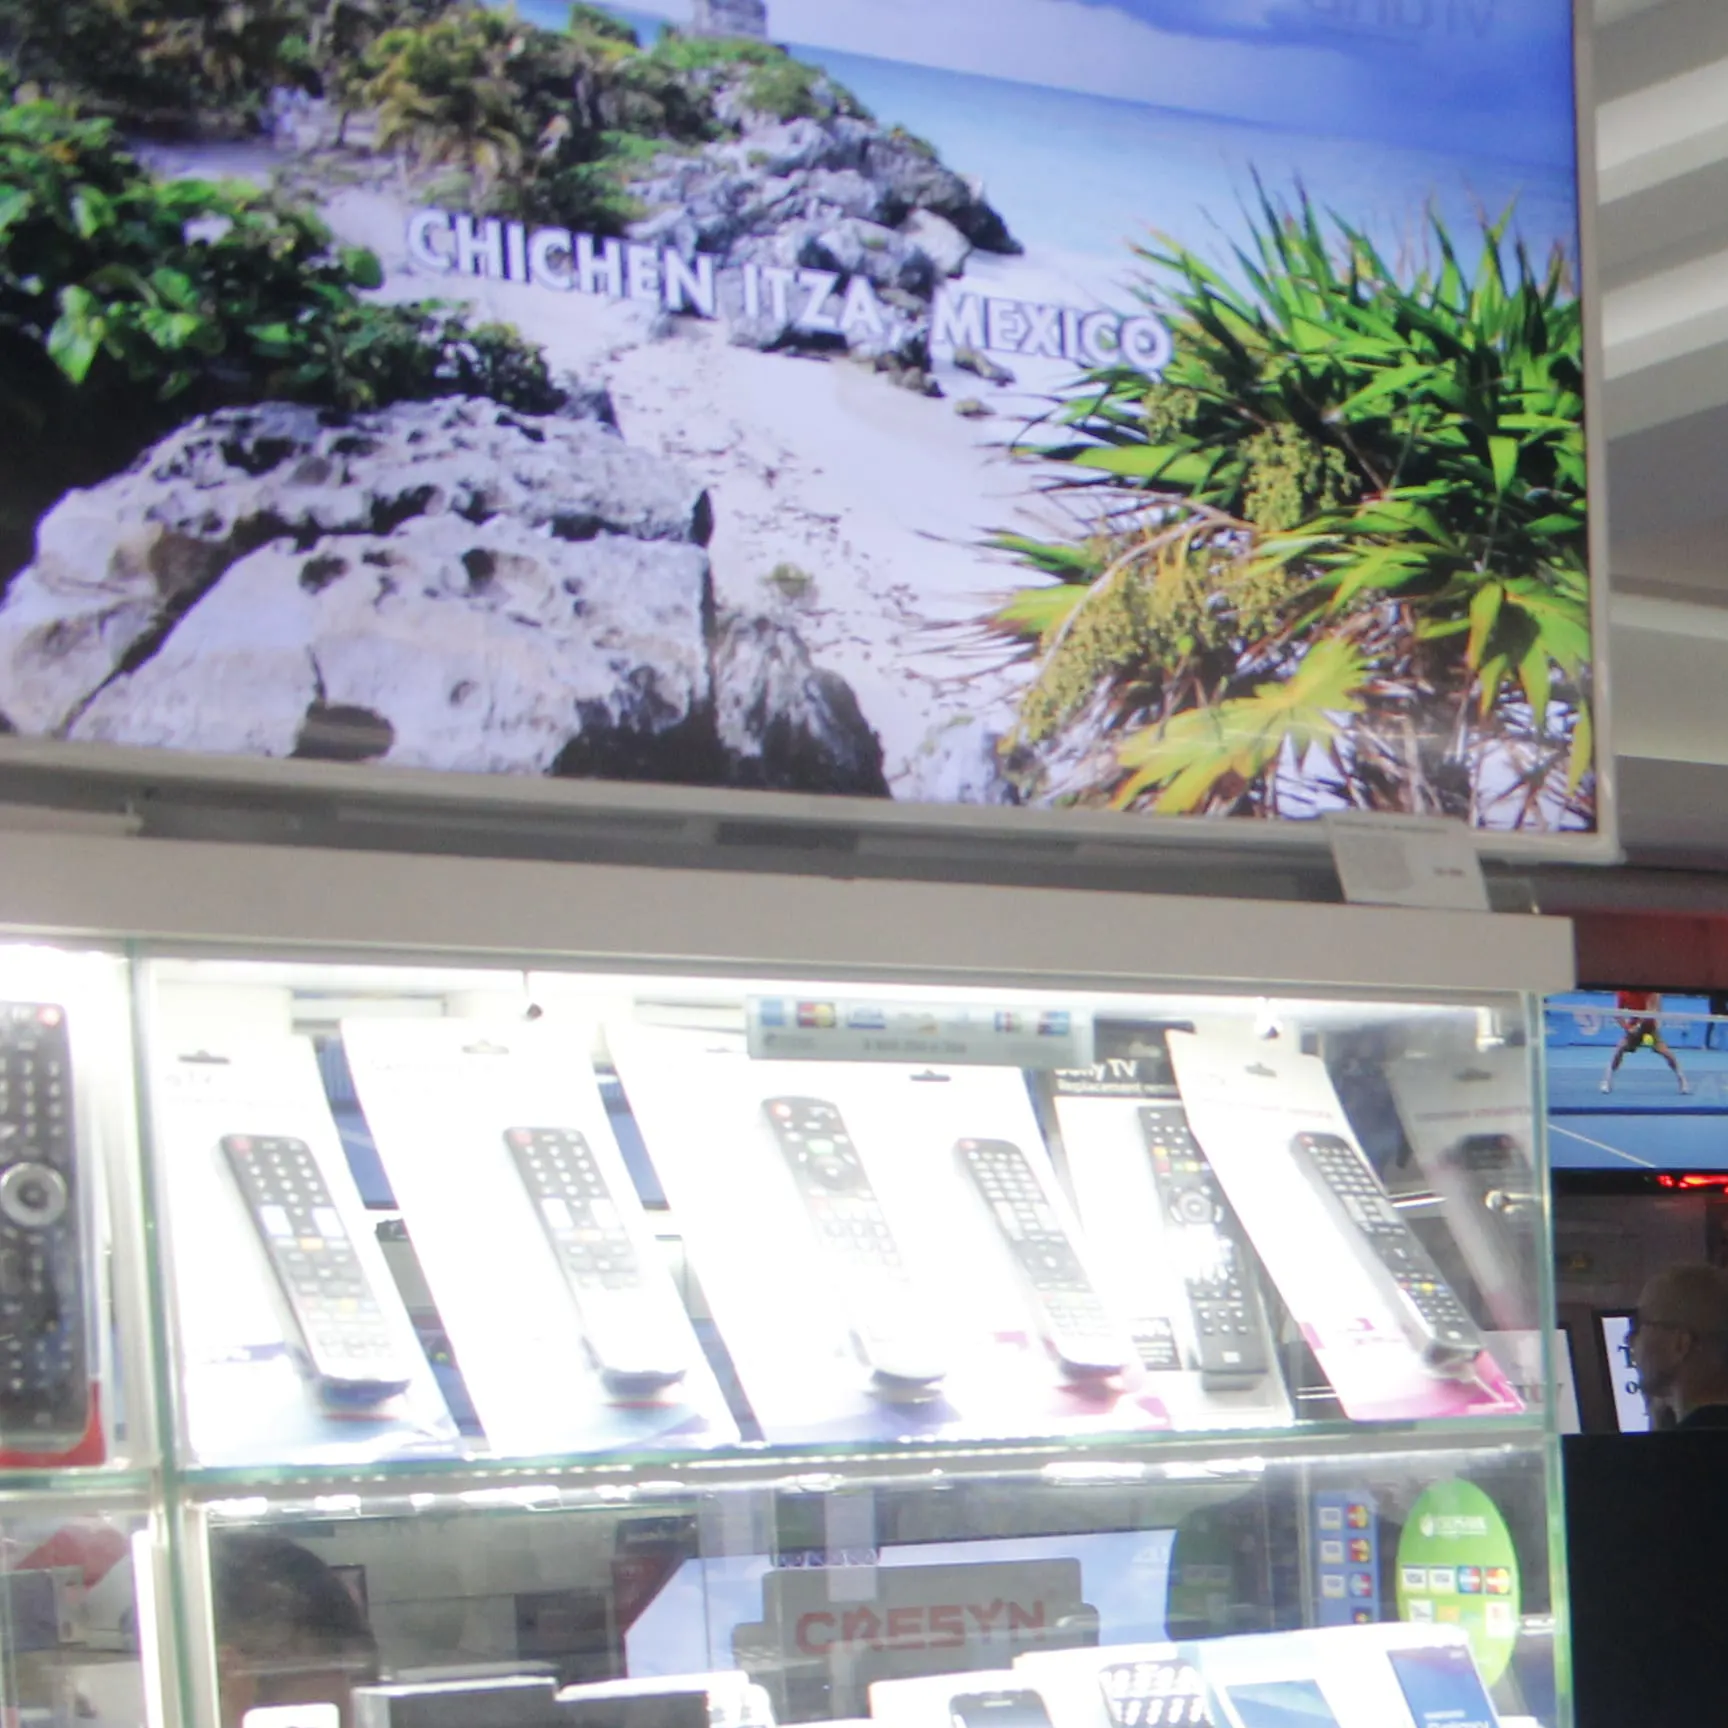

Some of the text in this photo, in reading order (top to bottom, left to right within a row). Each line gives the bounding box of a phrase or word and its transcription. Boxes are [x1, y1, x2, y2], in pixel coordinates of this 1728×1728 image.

[406, 208, 714, 317] CHICHEN
[931, 286, 1174, 373] MEXICO
[794, 1598, 1047, 1655] CRESYN
